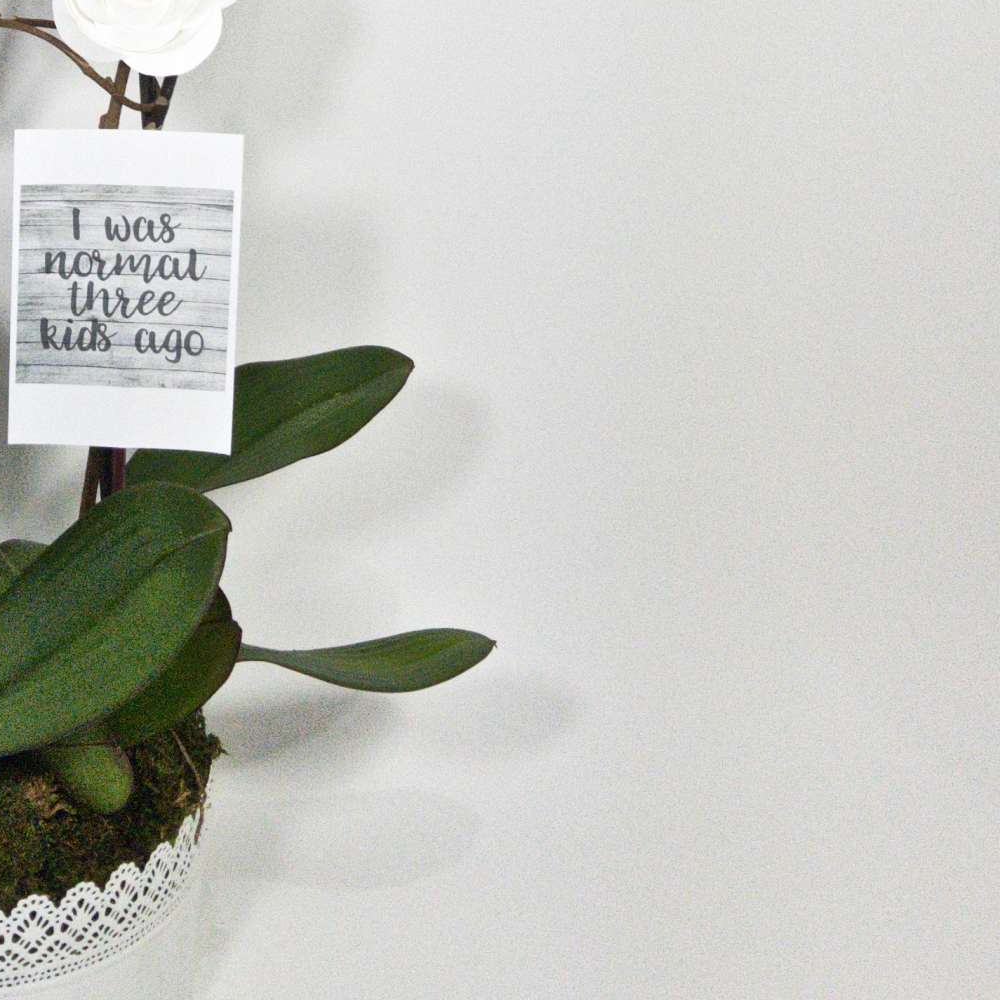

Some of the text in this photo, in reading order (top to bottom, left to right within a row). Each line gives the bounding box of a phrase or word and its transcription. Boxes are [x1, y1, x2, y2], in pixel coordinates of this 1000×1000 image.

[72, 207, 182, 243] I was
[44, 248, 207, 284] normal
[67, 281, 184, 318] three
[40, 317, 204, 364] kids ago
